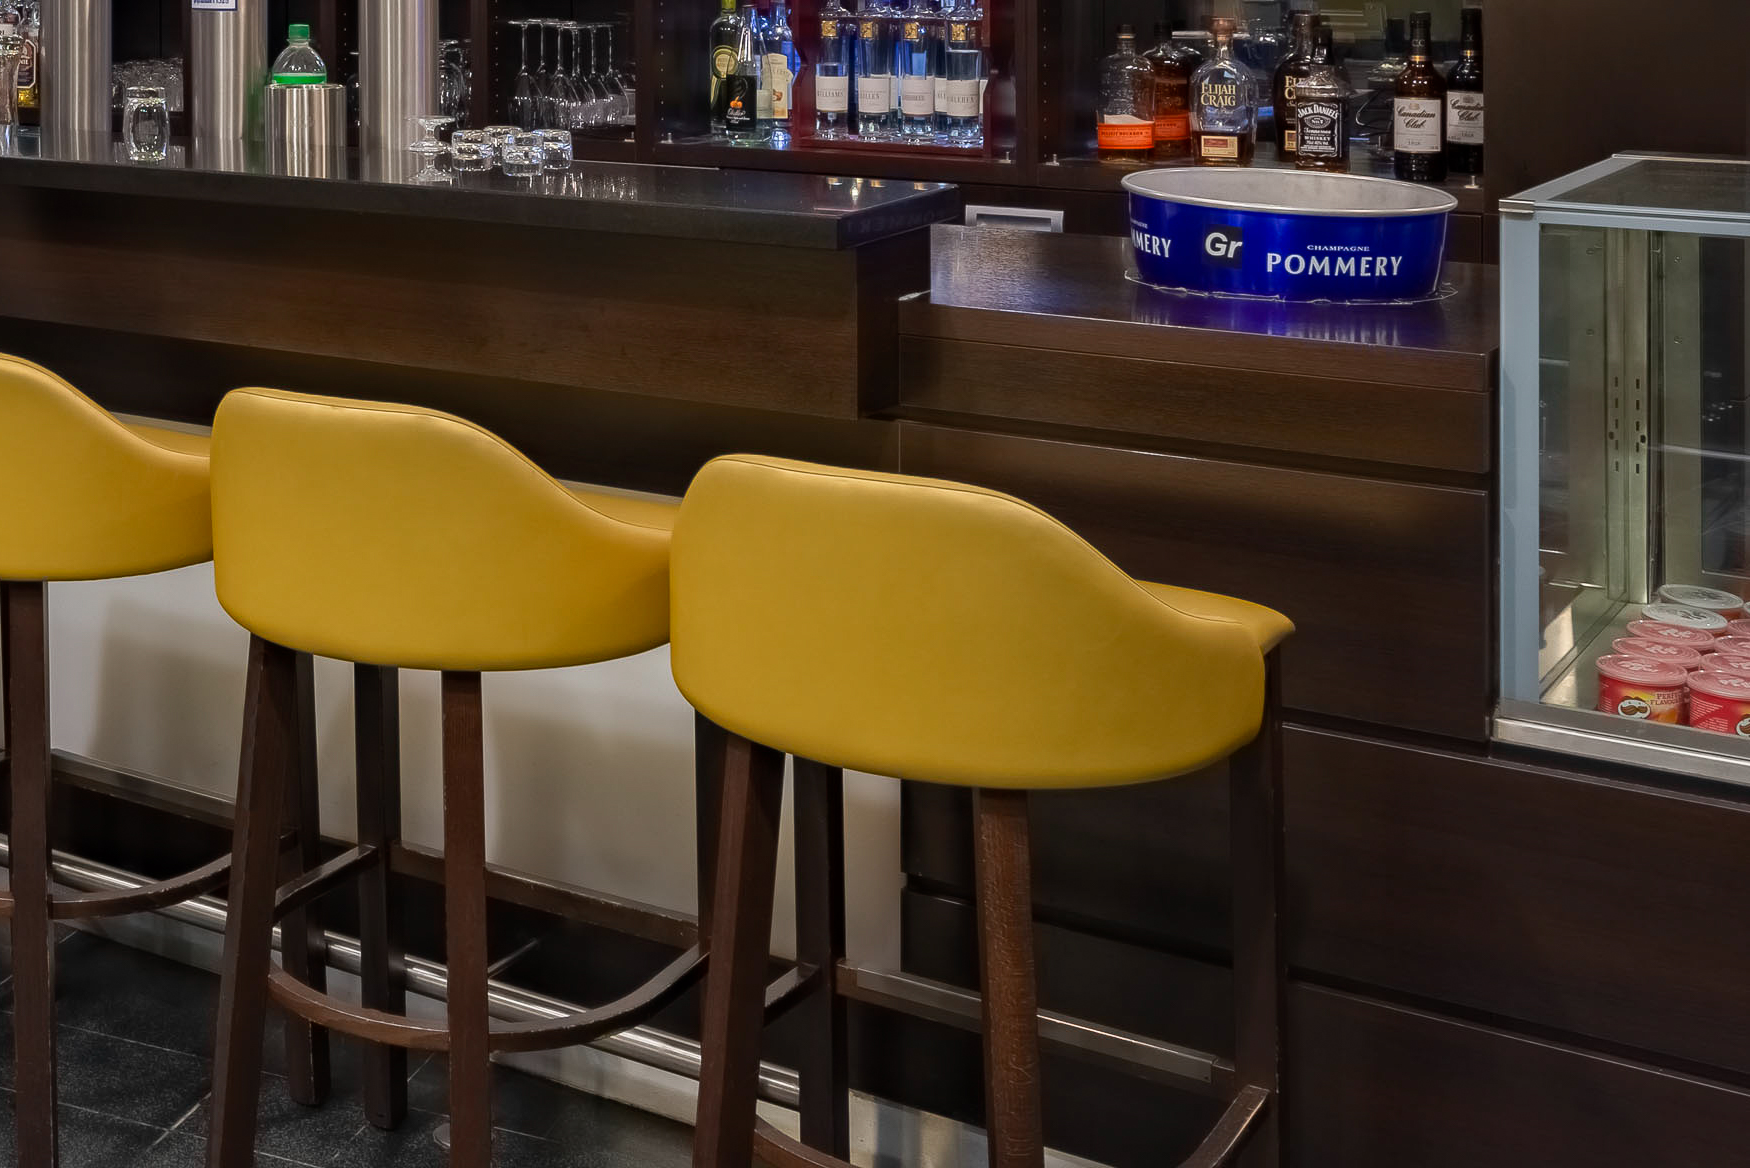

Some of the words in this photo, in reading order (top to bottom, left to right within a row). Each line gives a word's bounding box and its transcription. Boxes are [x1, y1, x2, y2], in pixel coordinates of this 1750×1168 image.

[1202, 83, 1236, 94] ELIJAH
[1200, 93, 1236, 108] CRAIG
[1297, 105, 1313, 118] JACK
[1313, 104, 1340, 120] DANIEL'S
[1397, 105, 1436, 119] Canadian
[1457, 110, 1481, 122] Club
[1403, 118, 1427, 130] Club
[1204, 231, 1243, 259] Gr
[1306, 244, 1370, 252] CHAMPAGNE
[1266, 252, 1403, 277] POMMERY
